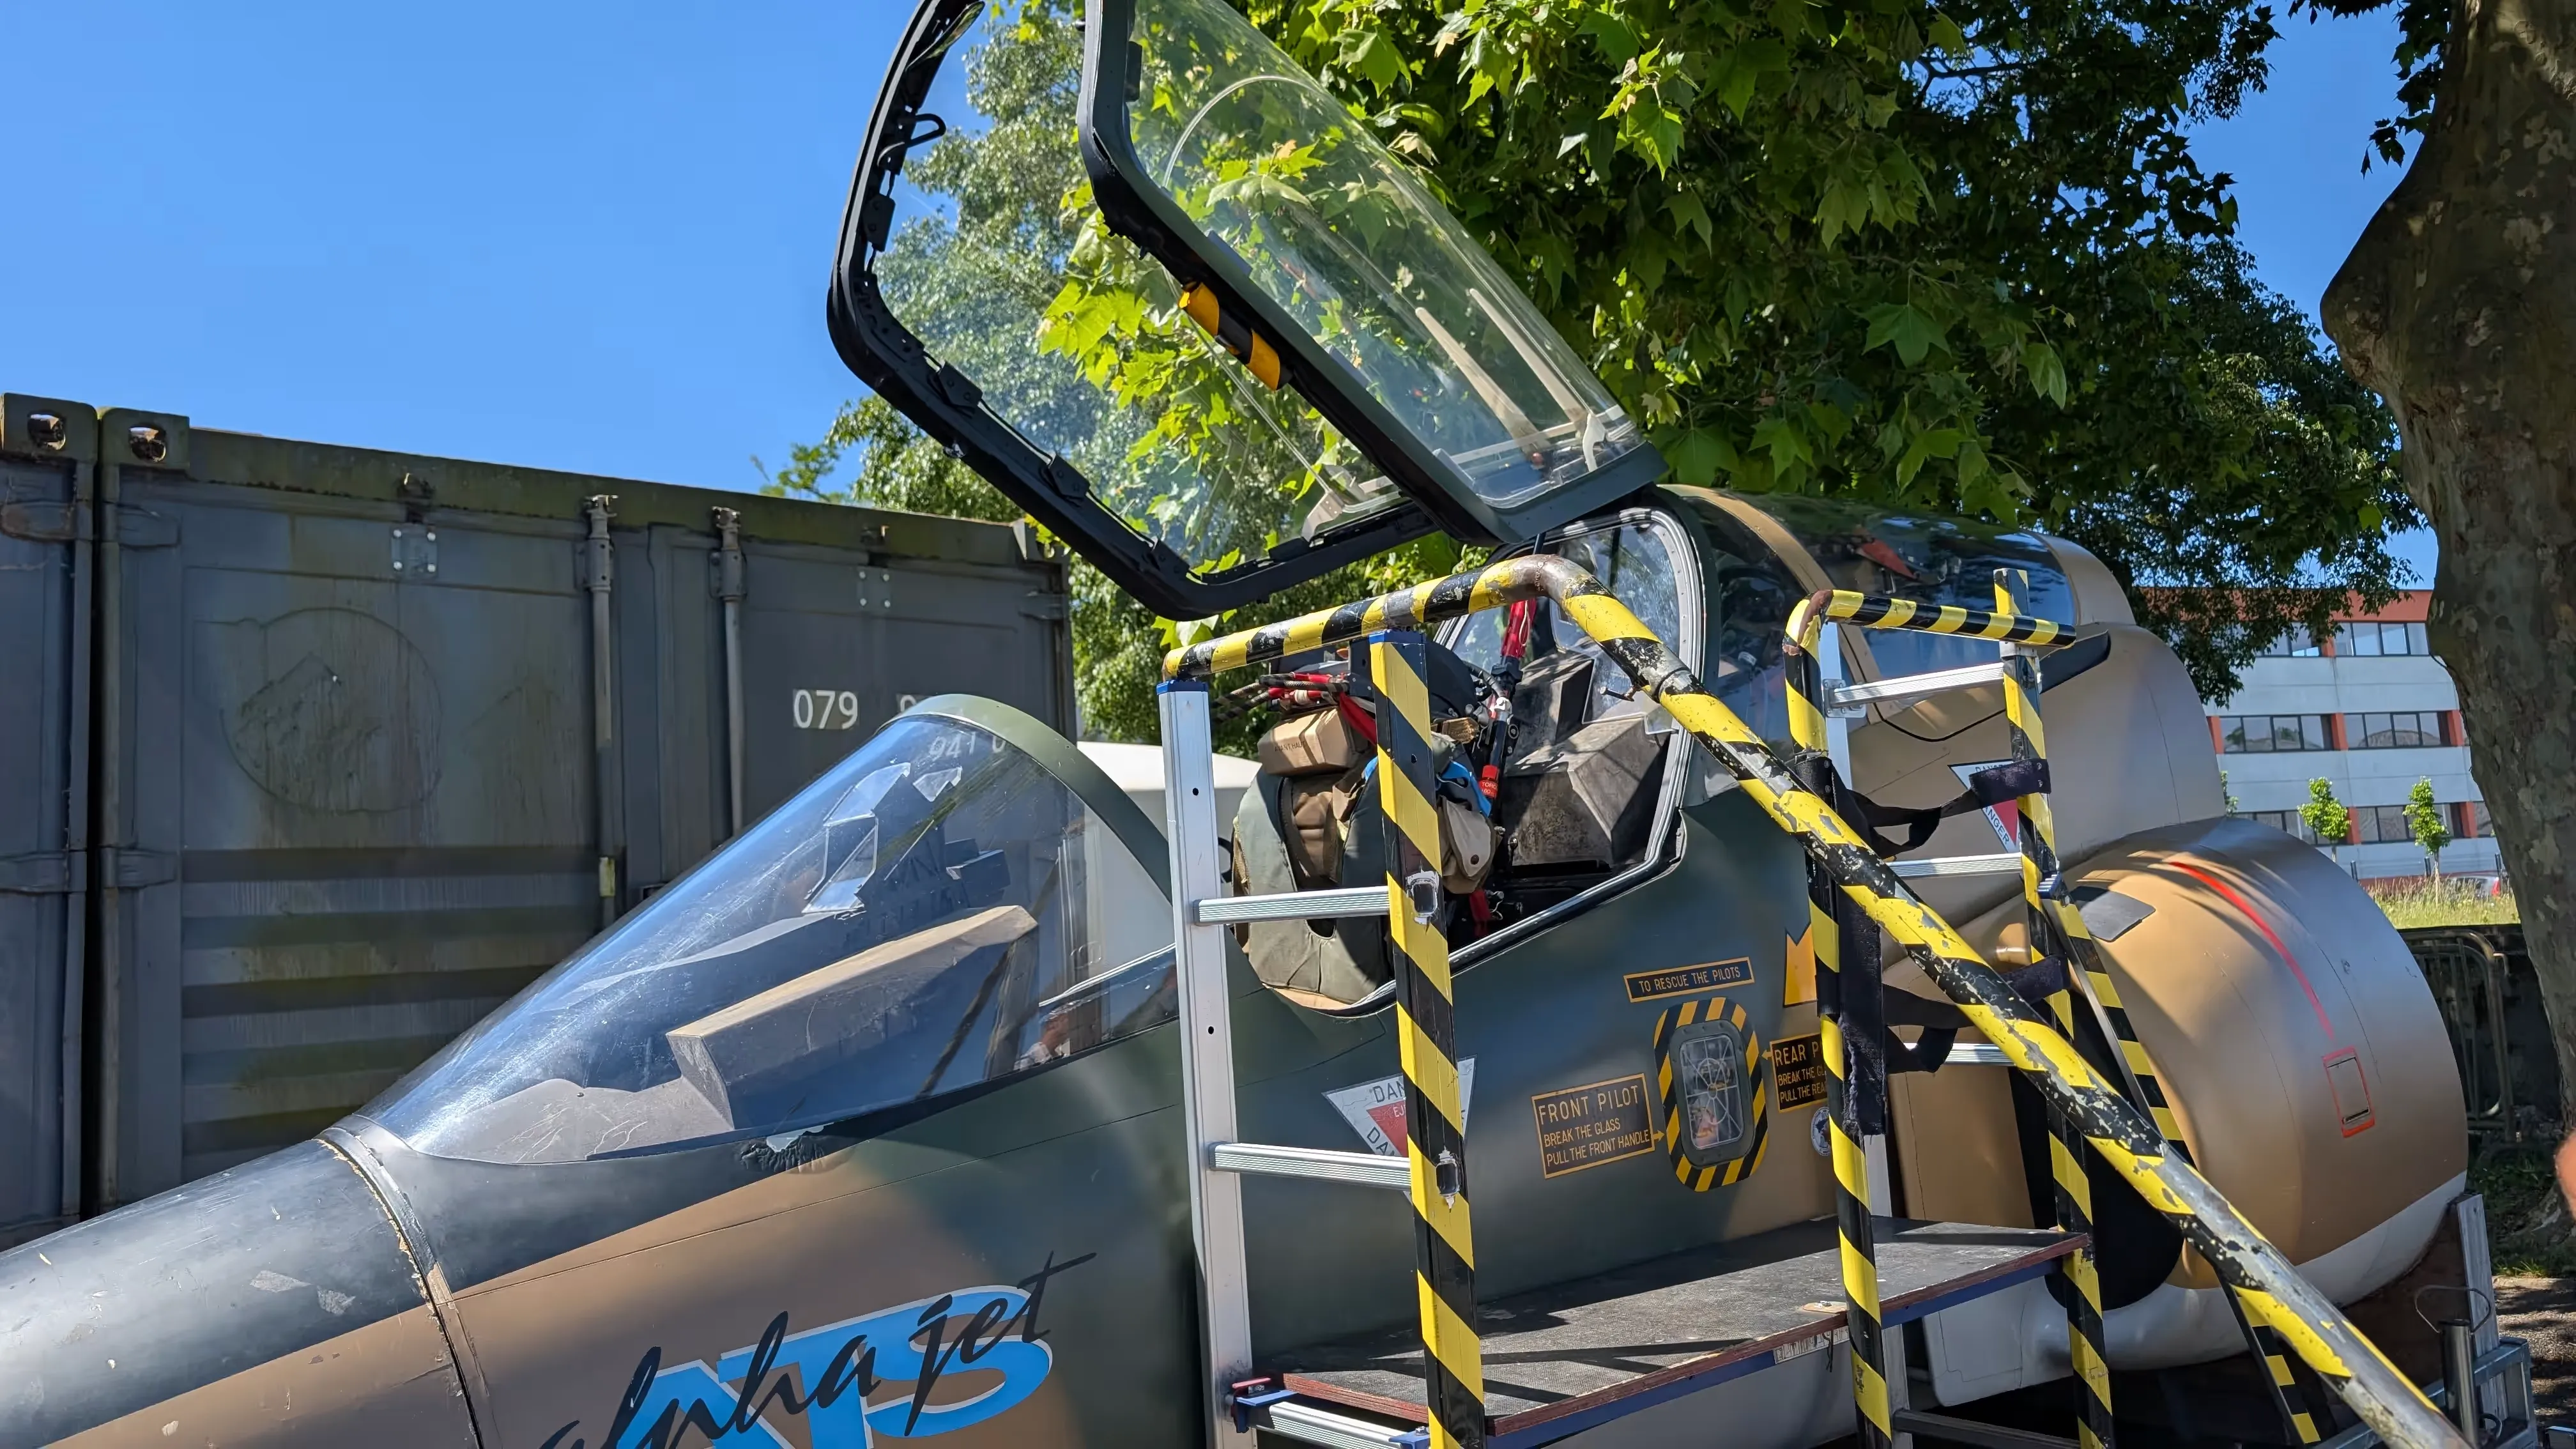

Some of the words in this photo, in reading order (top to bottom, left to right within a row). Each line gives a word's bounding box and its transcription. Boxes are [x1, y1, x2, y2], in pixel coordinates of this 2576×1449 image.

[793, 690, 858, 730] 079
[1639, 980, 1651, 993] TO
[1654, 974, 1689, 991] RESCUE
[1691, 971, 1709, 985] THE
[1712, 966, 1741, 981] PILOTS
[1774, 1044, 1807, 1066] REAR
[1778, 1070, 1801, 1086] BREAK
[1801, 1066, 1815, 1080] THE
[1372, 1080, 1404, 1103] DAN
[1538, 1096, 1588, 1125] FRONT
[1597, 1085, 1638, 1111] PILOT
[1780, 1089, 1798, 1103] PULL
[1797, 1085, 1811, 1099] THE
[1811, 1082, 1827, 1095] REA
[1544, 1128, 1574, 1147] BREAK
[1575, 1124, 1592, 1140] THE
[1594, 1117, 1621, 1135] GLASS
[1546, 1150, 1569, 1167] PULL
[1569, 1145, 1587, 1161] THE
[1589, 1137, 1615, 1156] FRONT
[1618, 1129, 1650, 1149] HANDLE
[908, 1250, 1097, 1437] jet
